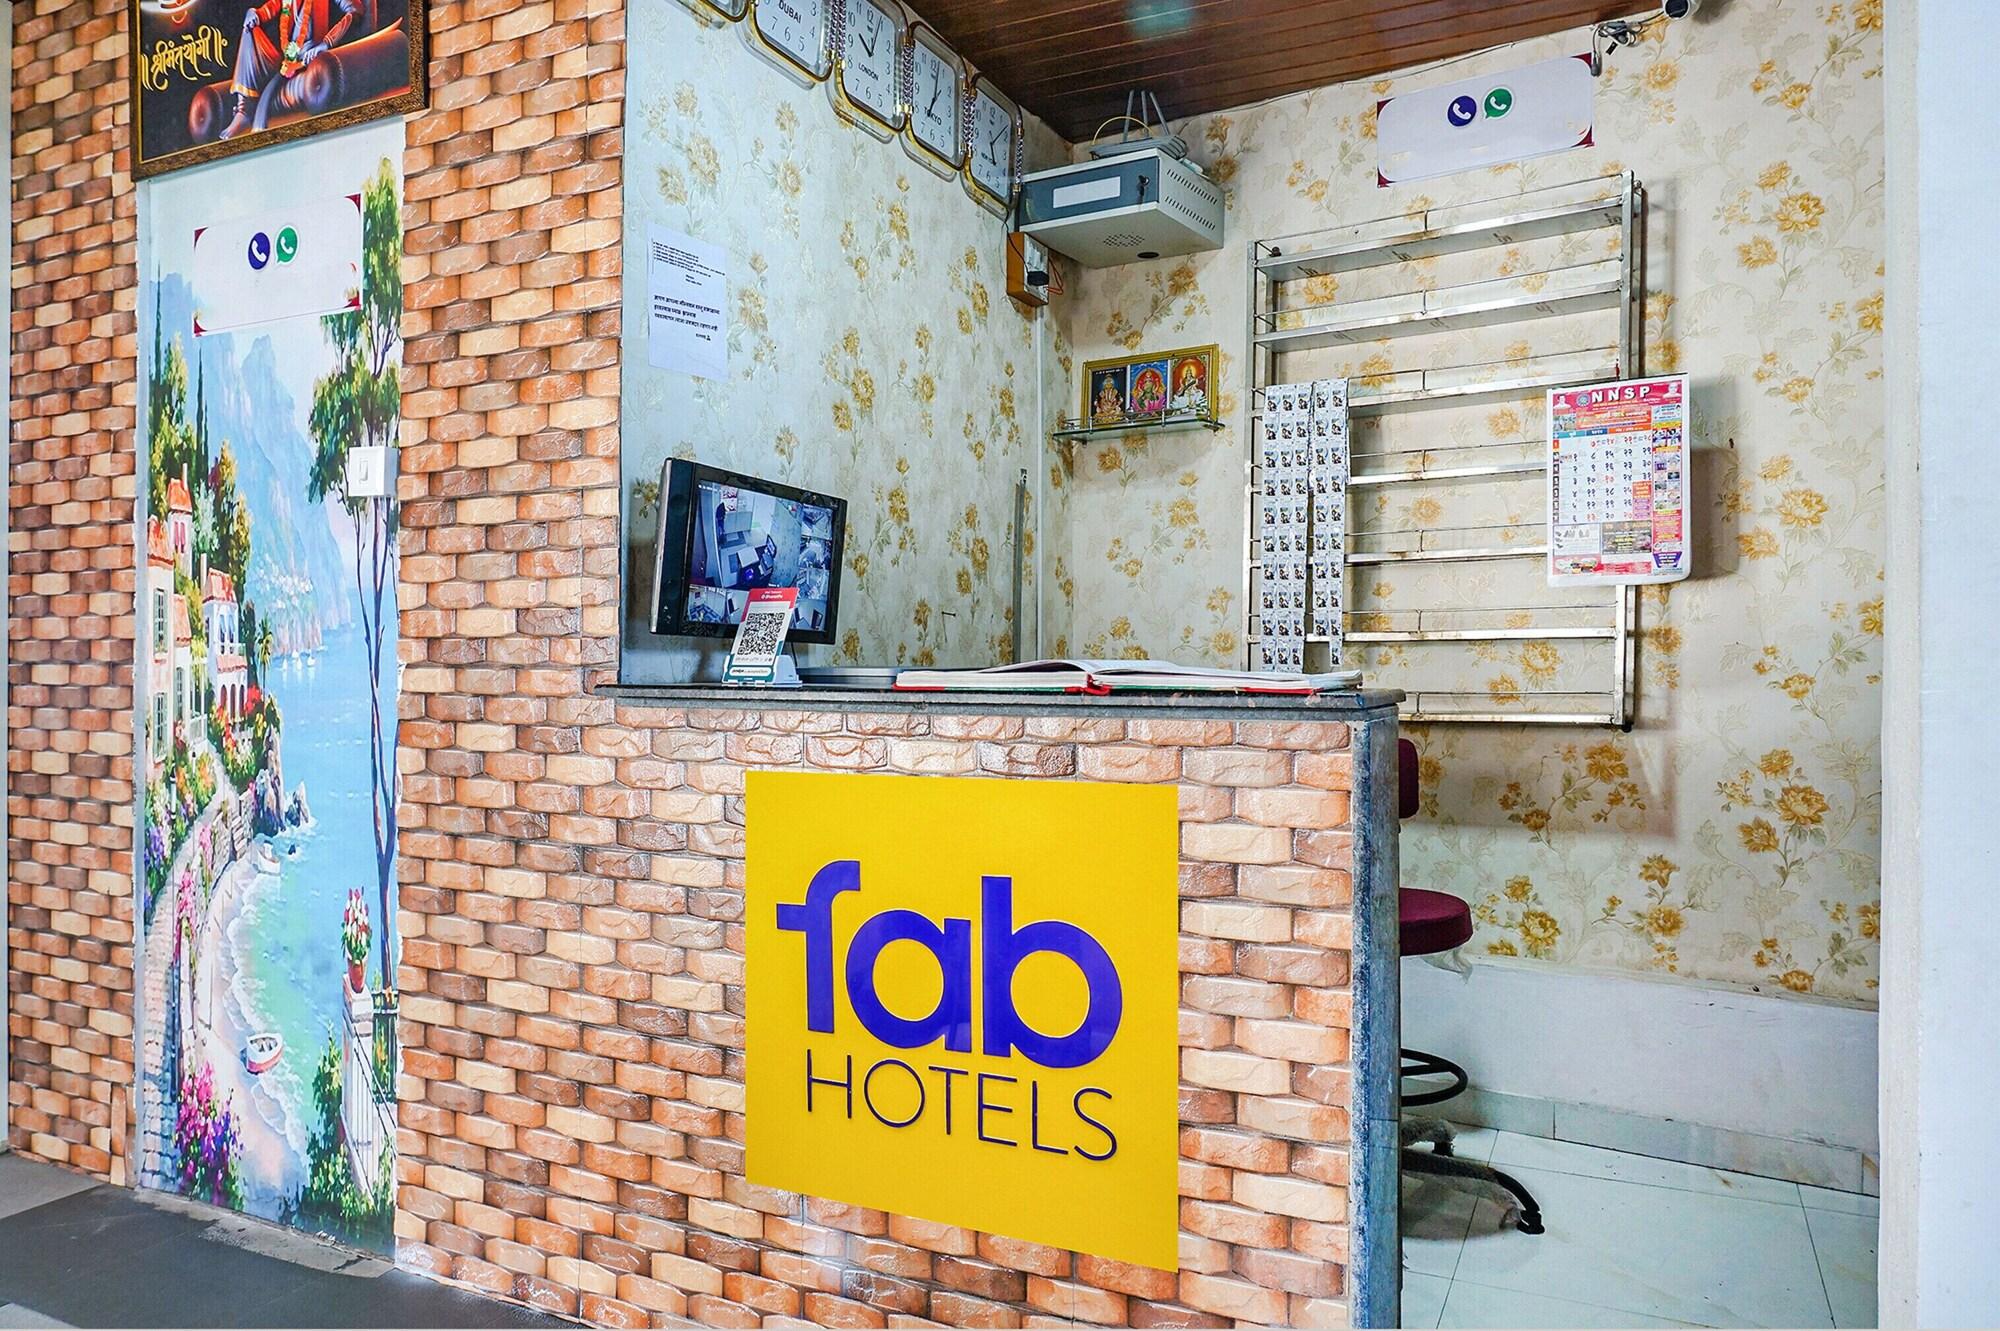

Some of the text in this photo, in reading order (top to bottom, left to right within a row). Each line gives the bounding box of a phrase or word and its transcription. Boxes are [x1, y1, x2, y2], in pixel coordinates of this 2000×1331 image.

[778, 0, 802, 24] DUBAI
[858, 62, 879, 81] LONDON
[776, 860, 1123, 1069] fab
[807, 1049, 1118, 1161] HOTELS
